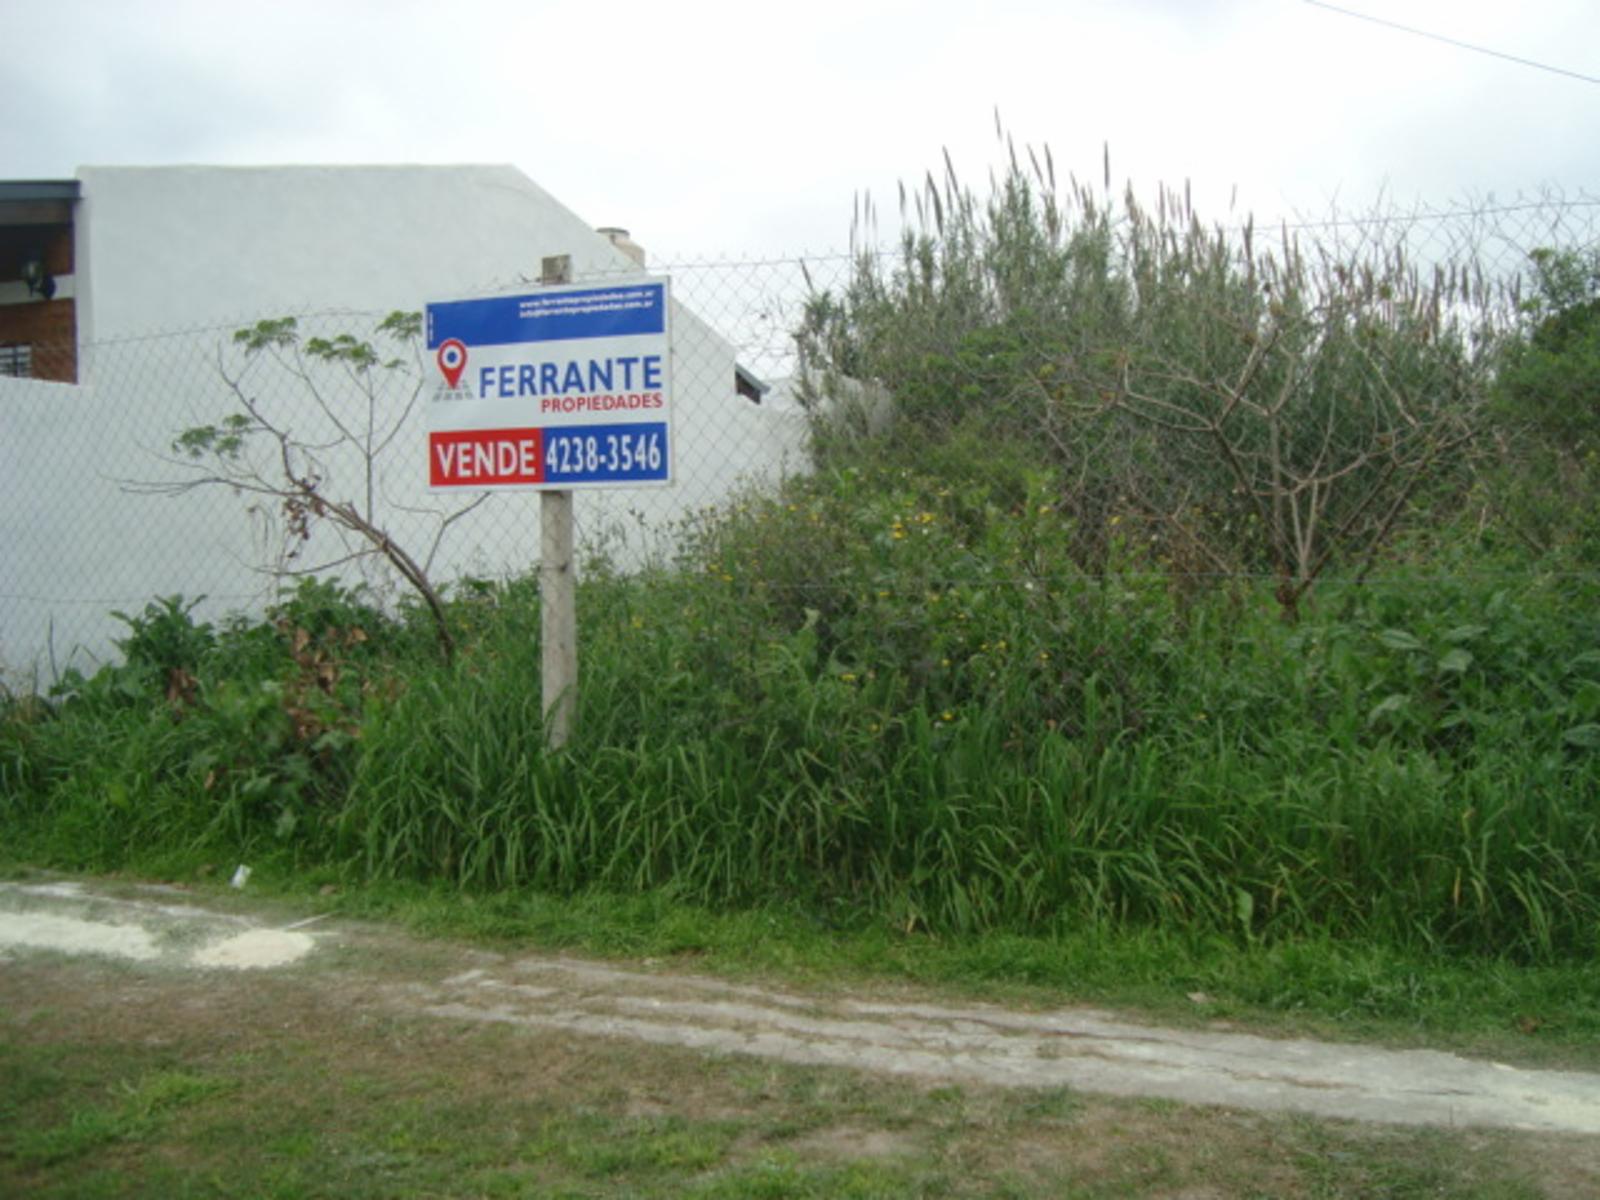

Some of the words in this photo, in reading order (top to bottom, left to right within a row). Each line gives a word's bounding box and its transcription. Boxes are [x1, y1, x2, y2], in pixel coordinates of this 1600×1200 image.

[479, 355, 662, 398] FERRANTE
[541, 393, 663, 413] PROPIEDADES
[436, 440, 535, 478] VENDE
[546, 434, 661, 473] 4238-3546
